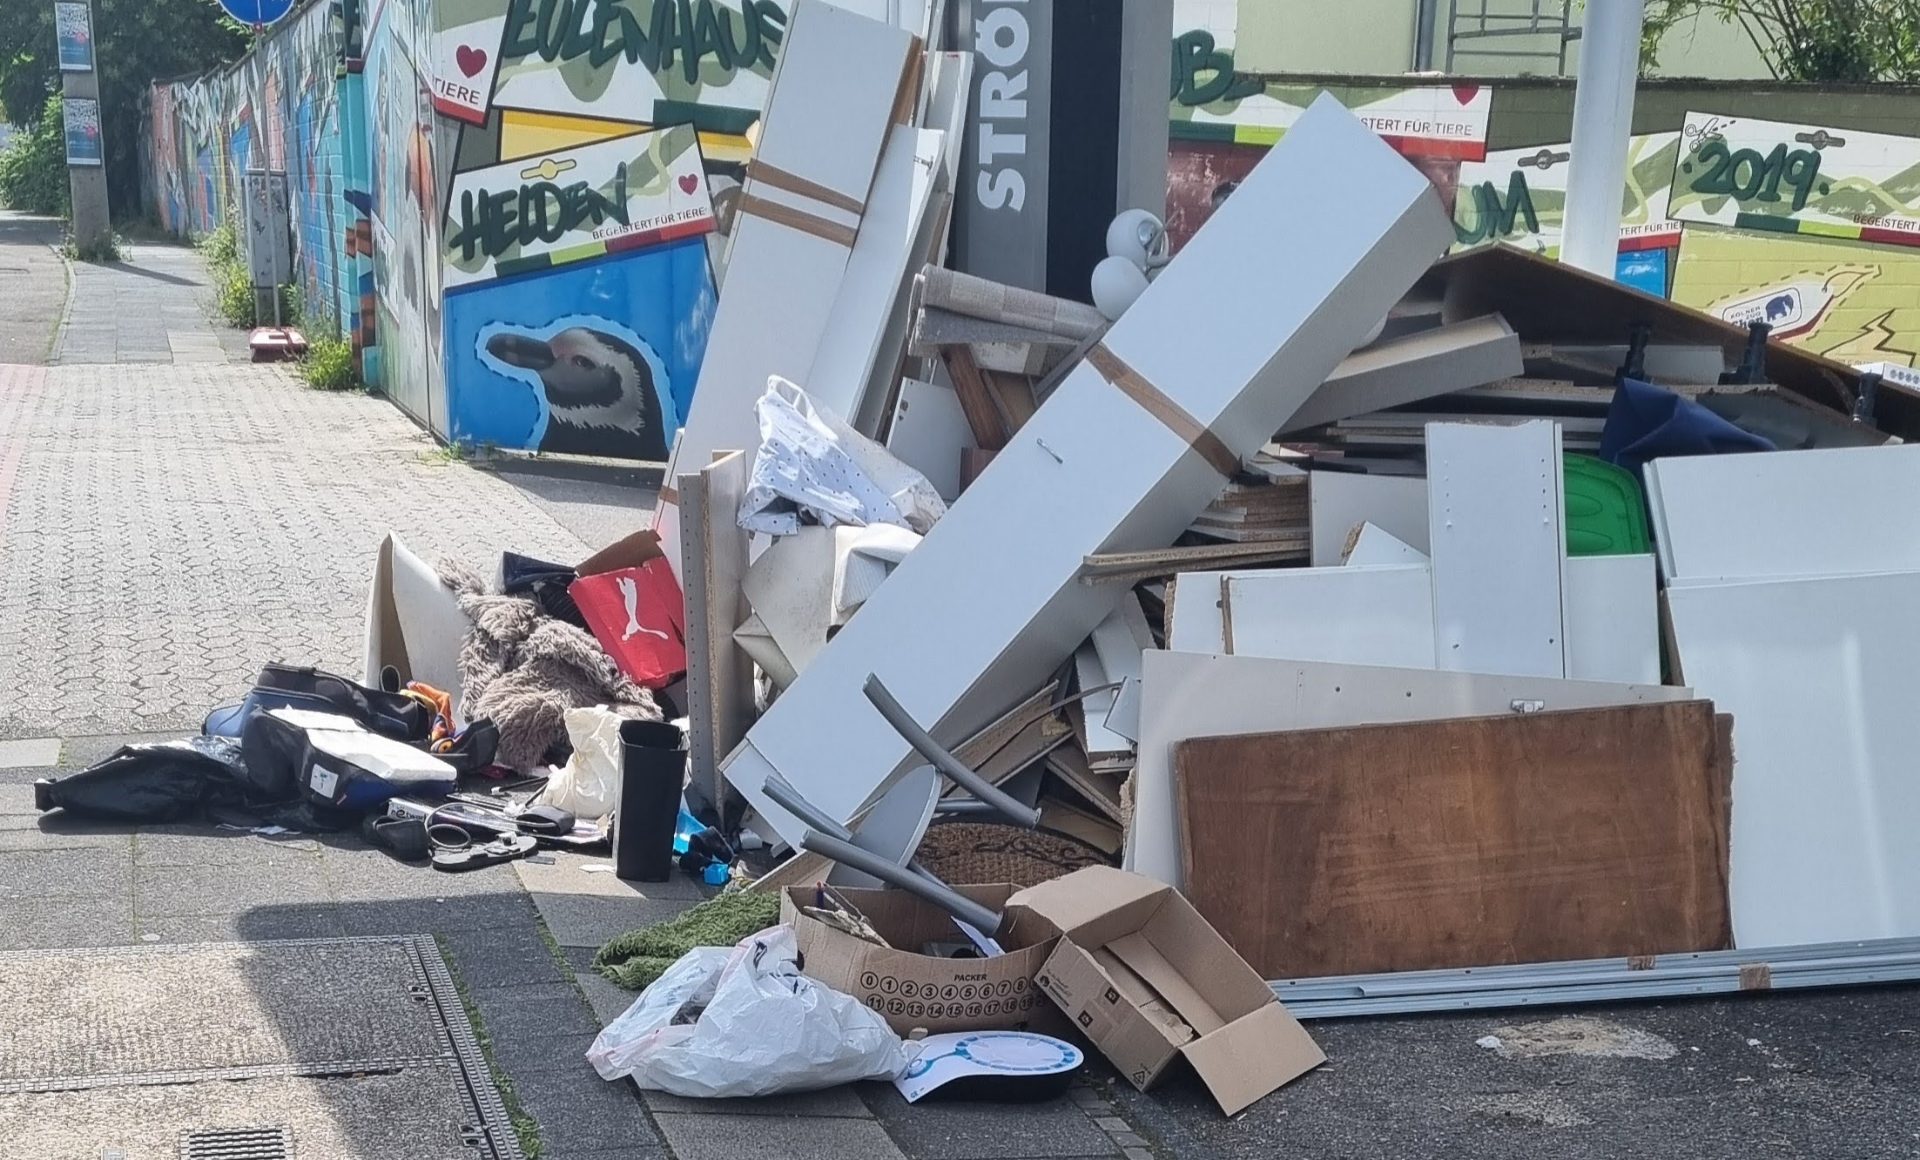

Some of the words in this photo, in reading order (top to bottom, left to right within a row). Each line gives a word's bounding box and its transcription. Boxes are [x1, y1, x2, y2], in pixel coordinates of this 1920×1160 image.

[433, 76, 481, 105] TIERE
[975, 0, 1030, 212] STRÖ
[1404, 118, 1431, 133] FÜR
[1435, 122, 1473, 136] TIERE
[449, 161, 630, 260] HELDEN
[592, 219, 653, 240] BEGEISTERT
[676, 206, 706, 221] TIERE
[1853, 214, 1917, 230] BEGEISTERT
[954, 974, 988, 982] PACKER
